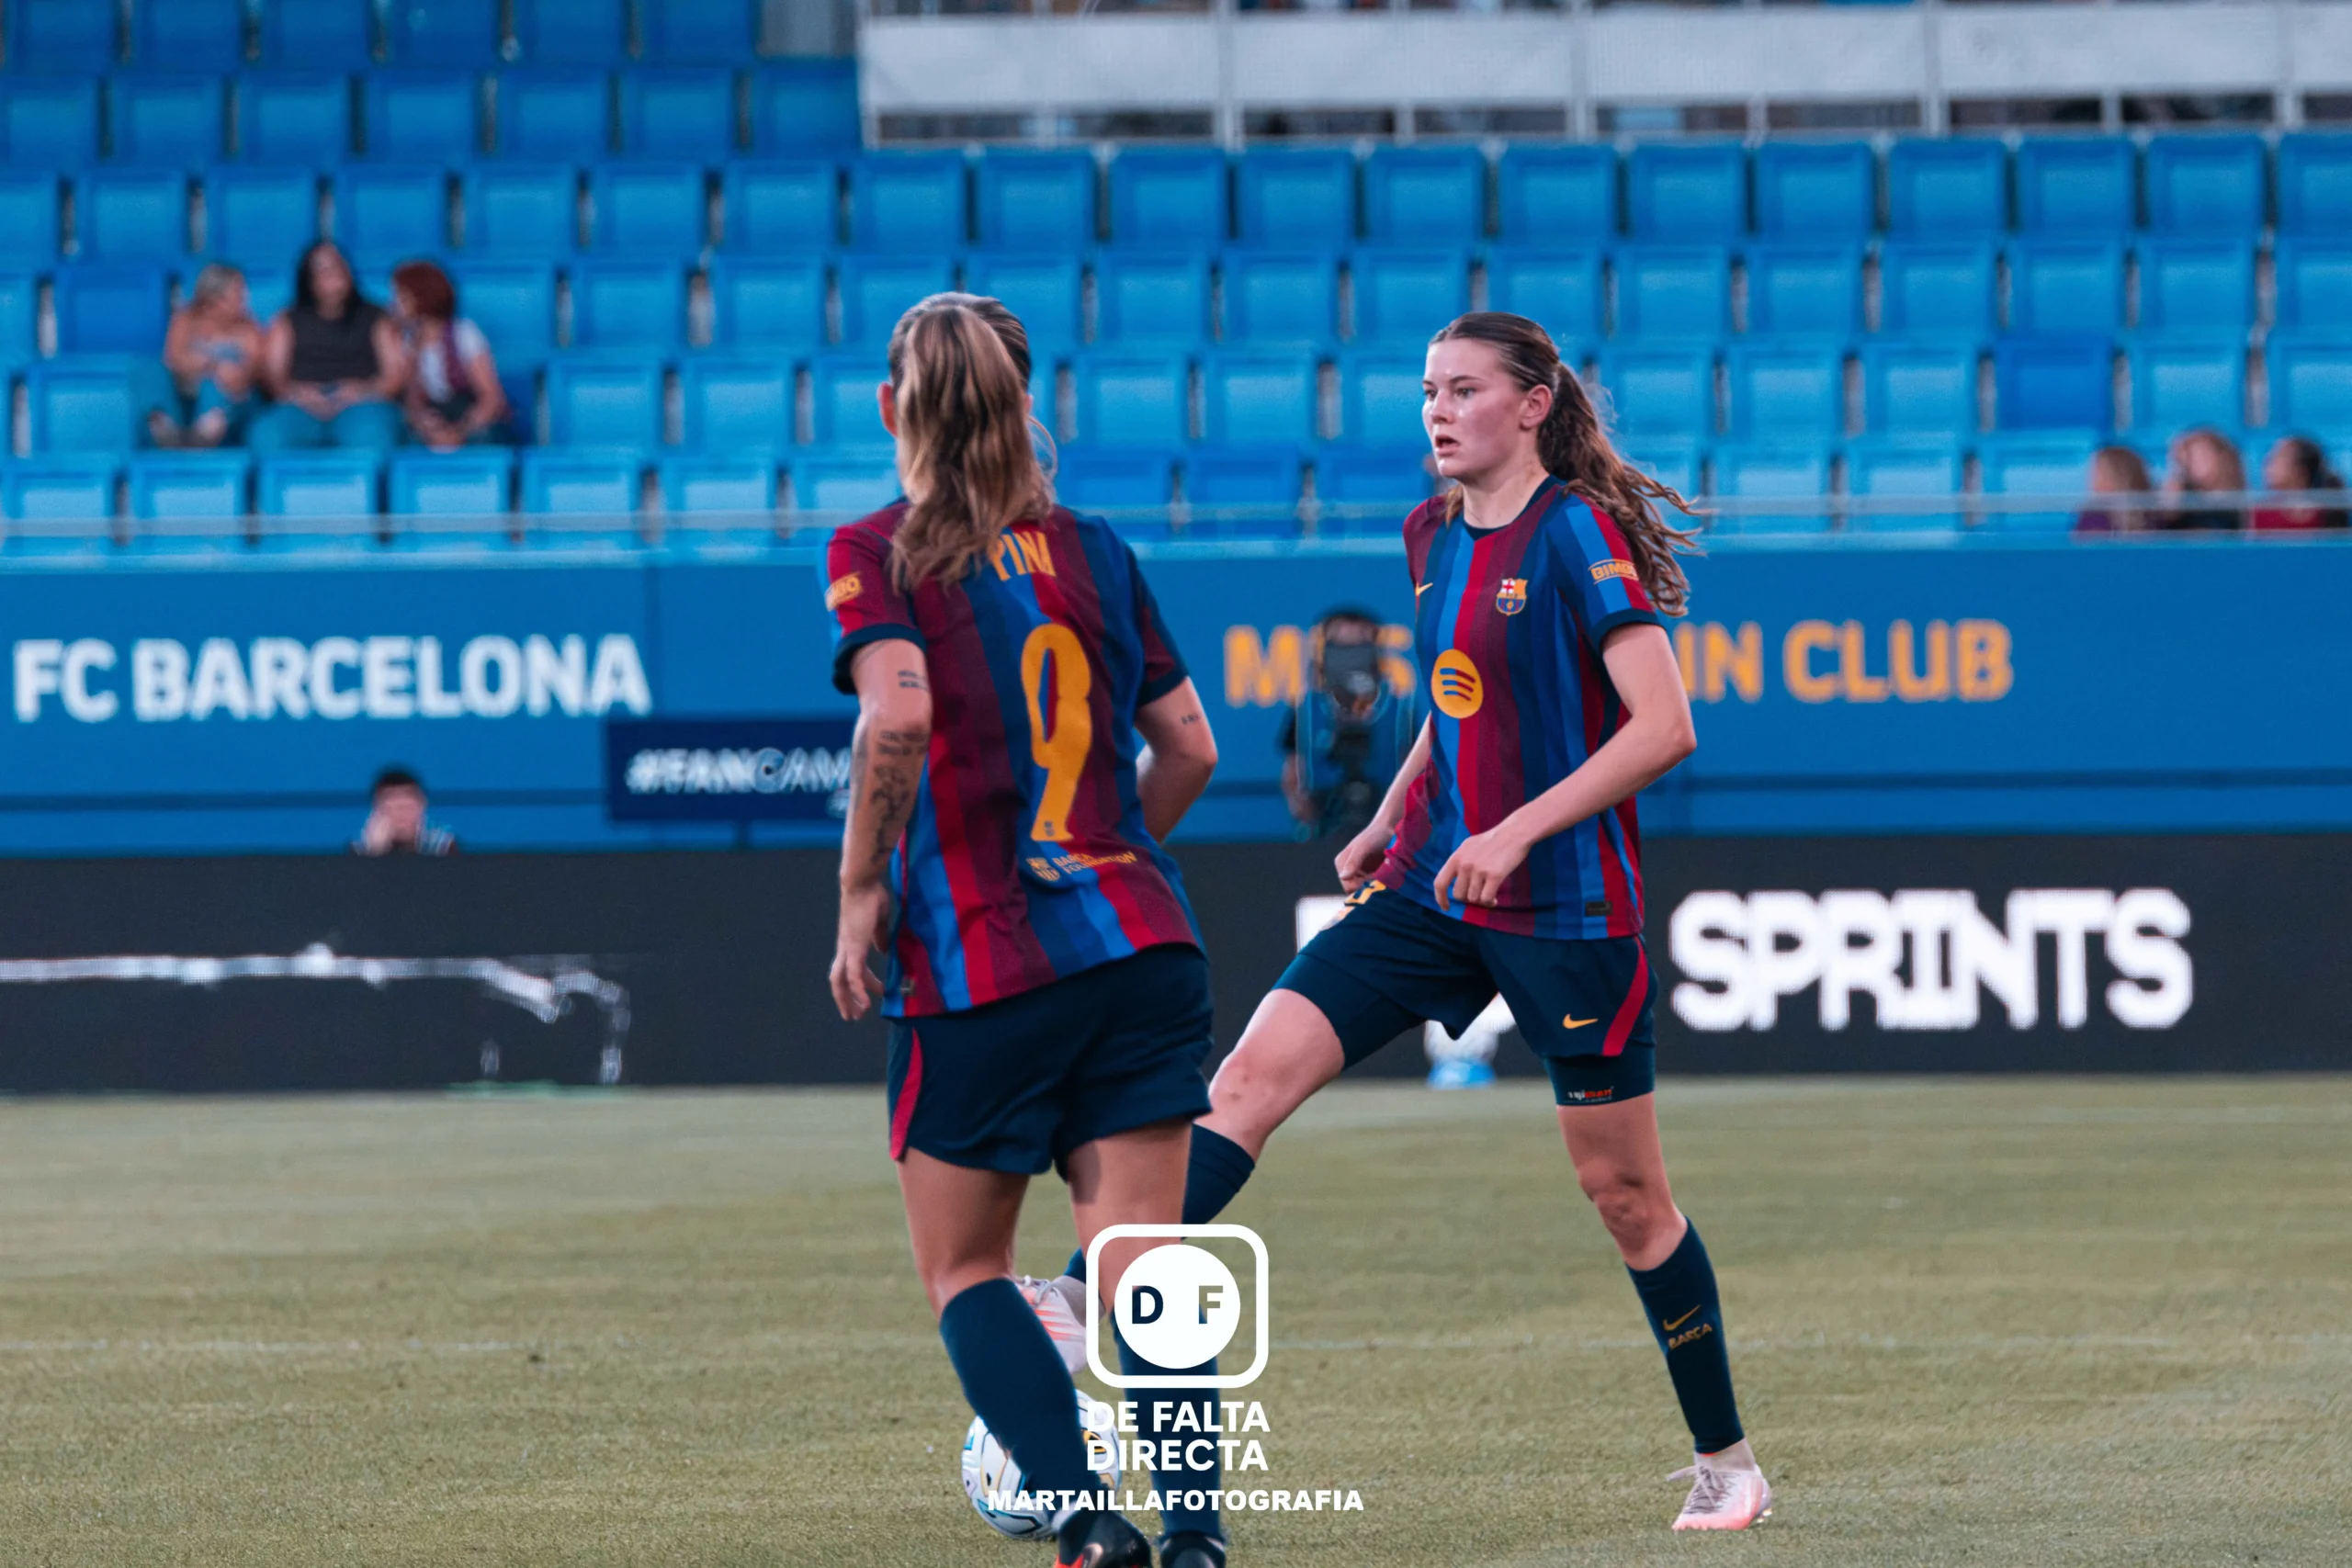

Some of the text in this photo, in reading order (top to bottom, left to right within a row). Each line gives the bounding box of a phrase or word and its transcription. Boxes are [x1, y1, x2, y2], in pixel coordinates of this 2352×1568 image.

[13, 634, 652, 723] FC BARCELONA
[1224, 624, 1416, 708] MS
[1782, 618, 2014, 704] CLUB
[1021, 623, 1093, 841] 9
[1669, 887, 2194, 1032] SPRINTS
